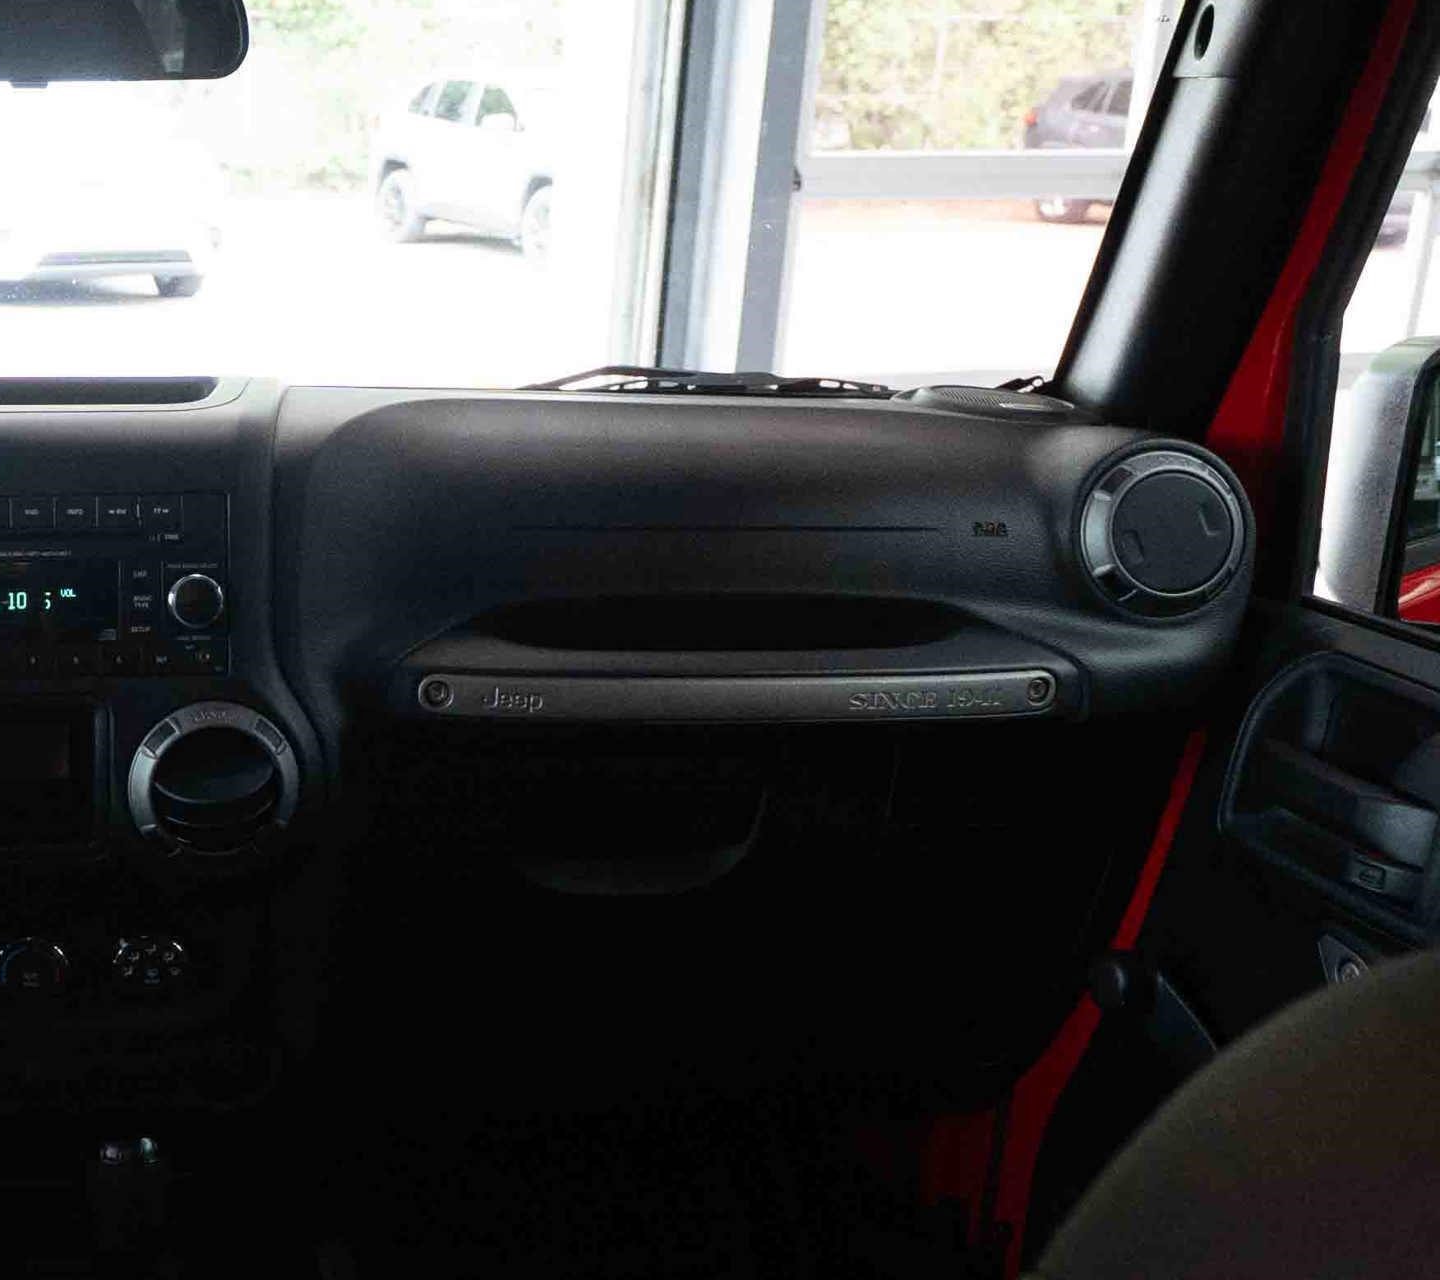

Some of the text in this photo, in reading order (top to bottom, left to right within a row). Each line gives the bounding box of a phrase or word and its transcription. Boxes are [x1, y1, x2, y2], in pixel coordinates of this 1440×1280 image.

[60, 588, 77, 598] VOL
[481, 686, 544, 713] Jeep
[848, 691, 938, 710] SINCE
